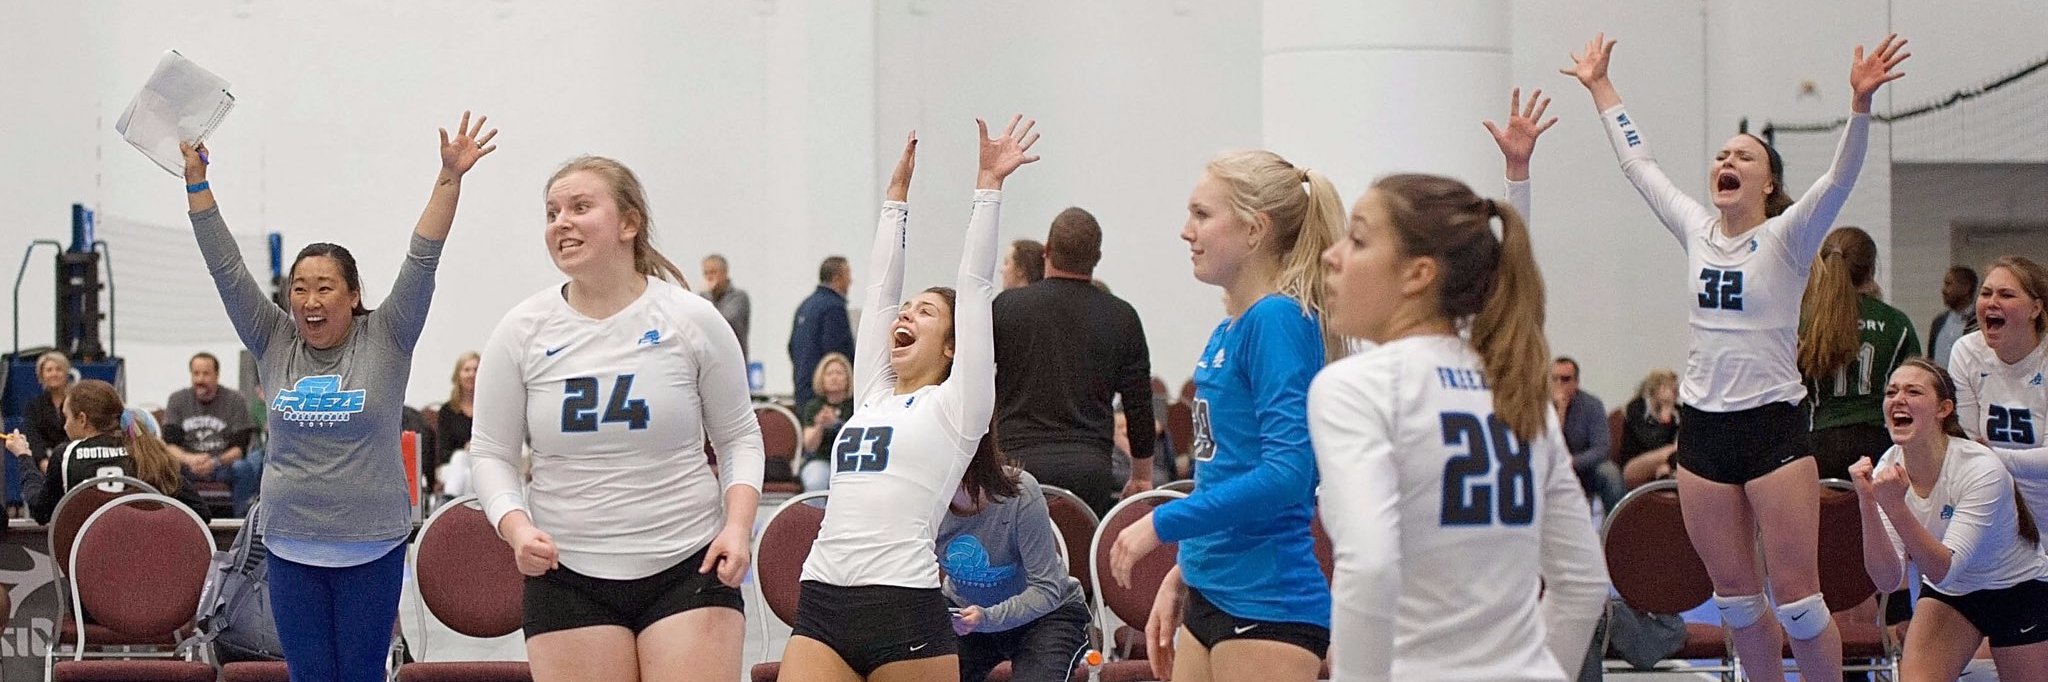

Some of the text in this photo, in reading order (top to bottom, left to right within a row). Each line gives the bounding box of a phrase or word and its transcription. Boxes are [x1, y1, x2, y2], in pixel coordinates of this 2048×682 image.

[1616, 112, 1641, 148] WE ARE
[1697, 267, 1744, 312] 32
[1857, 319, 1886, 333] ORY
[1436, 367, 1494, 391] FREEZ
[1833, 342, 1875, 397] 11
[271, 388, 366, 413] FREEZE
[283, 411, 350, 421] VOLLEYBALL
[560, 373, 651, 433] 24
[1986, 404, 2036, 445] 25
[76, 446, 130, 460] SOUTHWE
[836, 426, 894, 473] 23
[1440, 411, 1535, 526] 28
